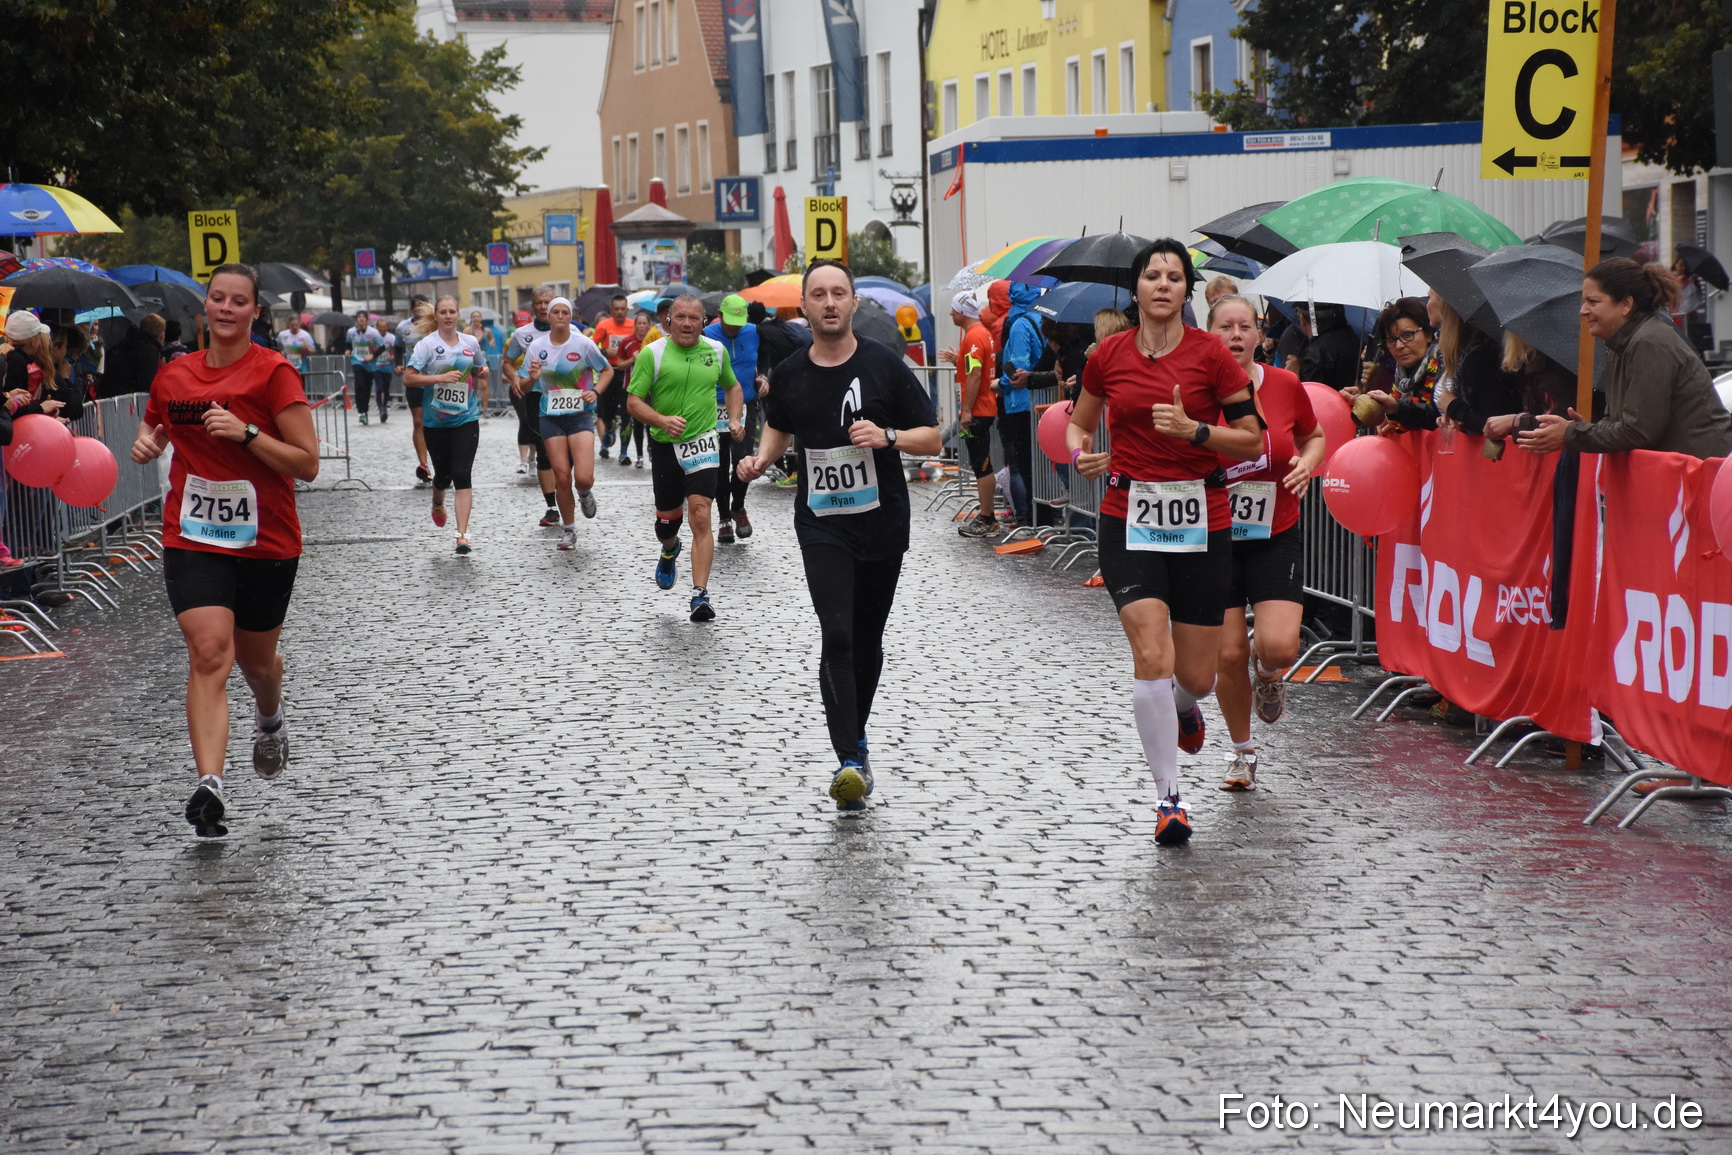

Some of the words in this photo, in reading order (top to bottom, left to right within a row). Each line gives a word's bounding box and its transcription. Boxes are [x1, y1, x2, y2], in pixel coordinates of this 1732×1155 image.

[1503, 1, 1599, 34] Block
[981, 29, 1010, 61] HOTEL
[1515, 49, 1579, 140] C
[809, 199, 843, 212] Block
[194, 213, 231, 227] Block
[816, 218, 837, 251] D
[203, 232, 227, 266] D
[490, 265, 507, 273] TAXI
[437, 388, 465, 404] 2053
[551, 397, 580, 410] 2282
[680, 437, 716, 459] 2504
[831, 447, 866, 459] BOCK
[1237, 462, 1256, 473] DEHN
[813, 460, 868, 491] 2601
[210, 483, 248, 492] BOCK
[189, 493, 251, 522] 2754
[830, 497, 855, 507] Ryan
[1136, 498, 1201, 526] 2109
[200, 526, 236, 539] Nadine
[1149, 532, 1185, 543] Sabine
